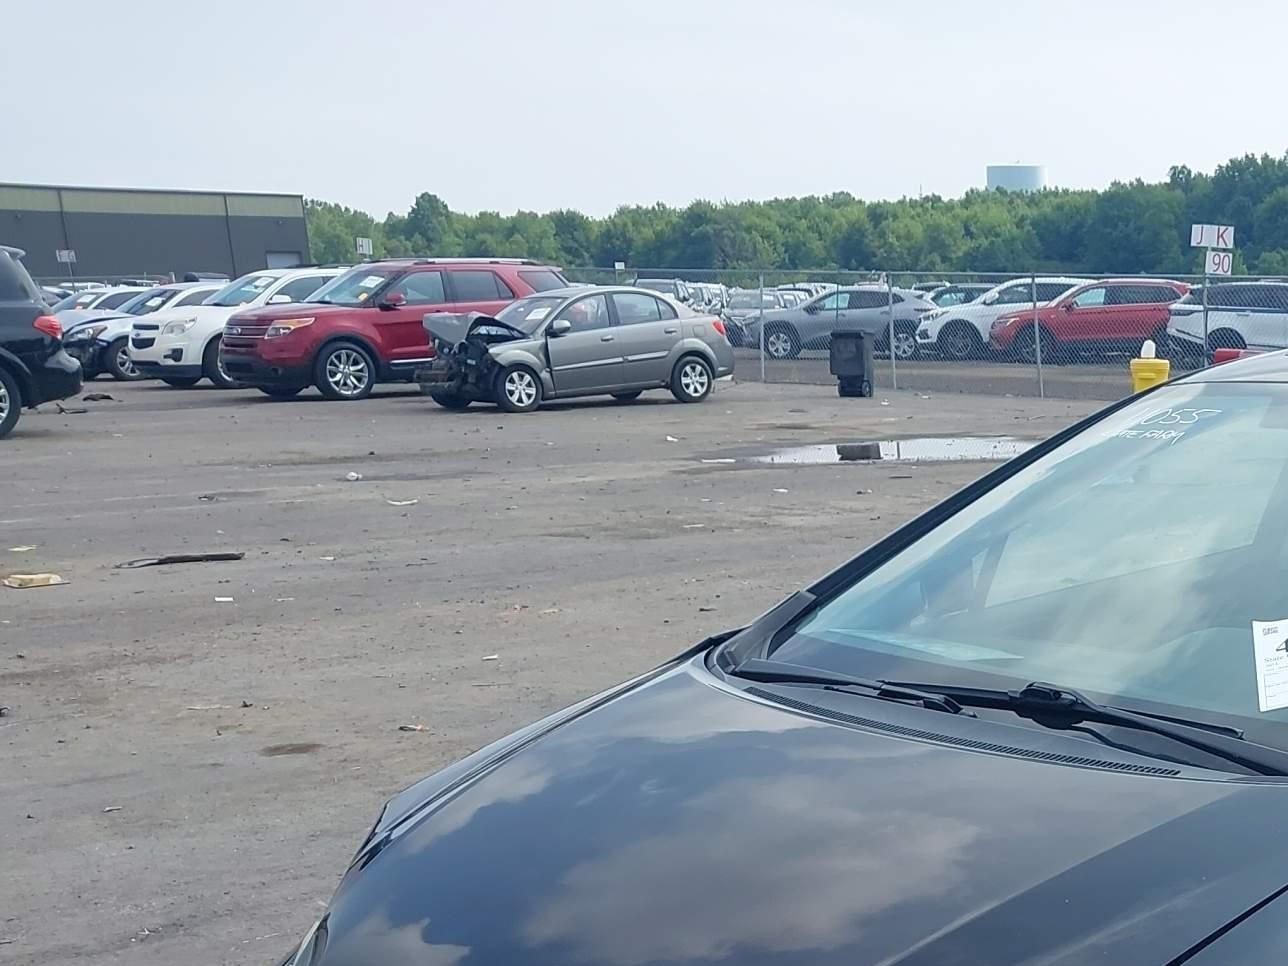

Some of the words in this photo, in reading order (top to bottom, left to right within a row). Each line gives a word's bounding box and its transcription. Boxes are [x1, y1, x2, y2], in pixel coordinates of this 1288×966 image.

[1196, 226, 1204, 245] J
[1216, 227, 1229, 247] K
[1212, 253, 1231, 273] 90
